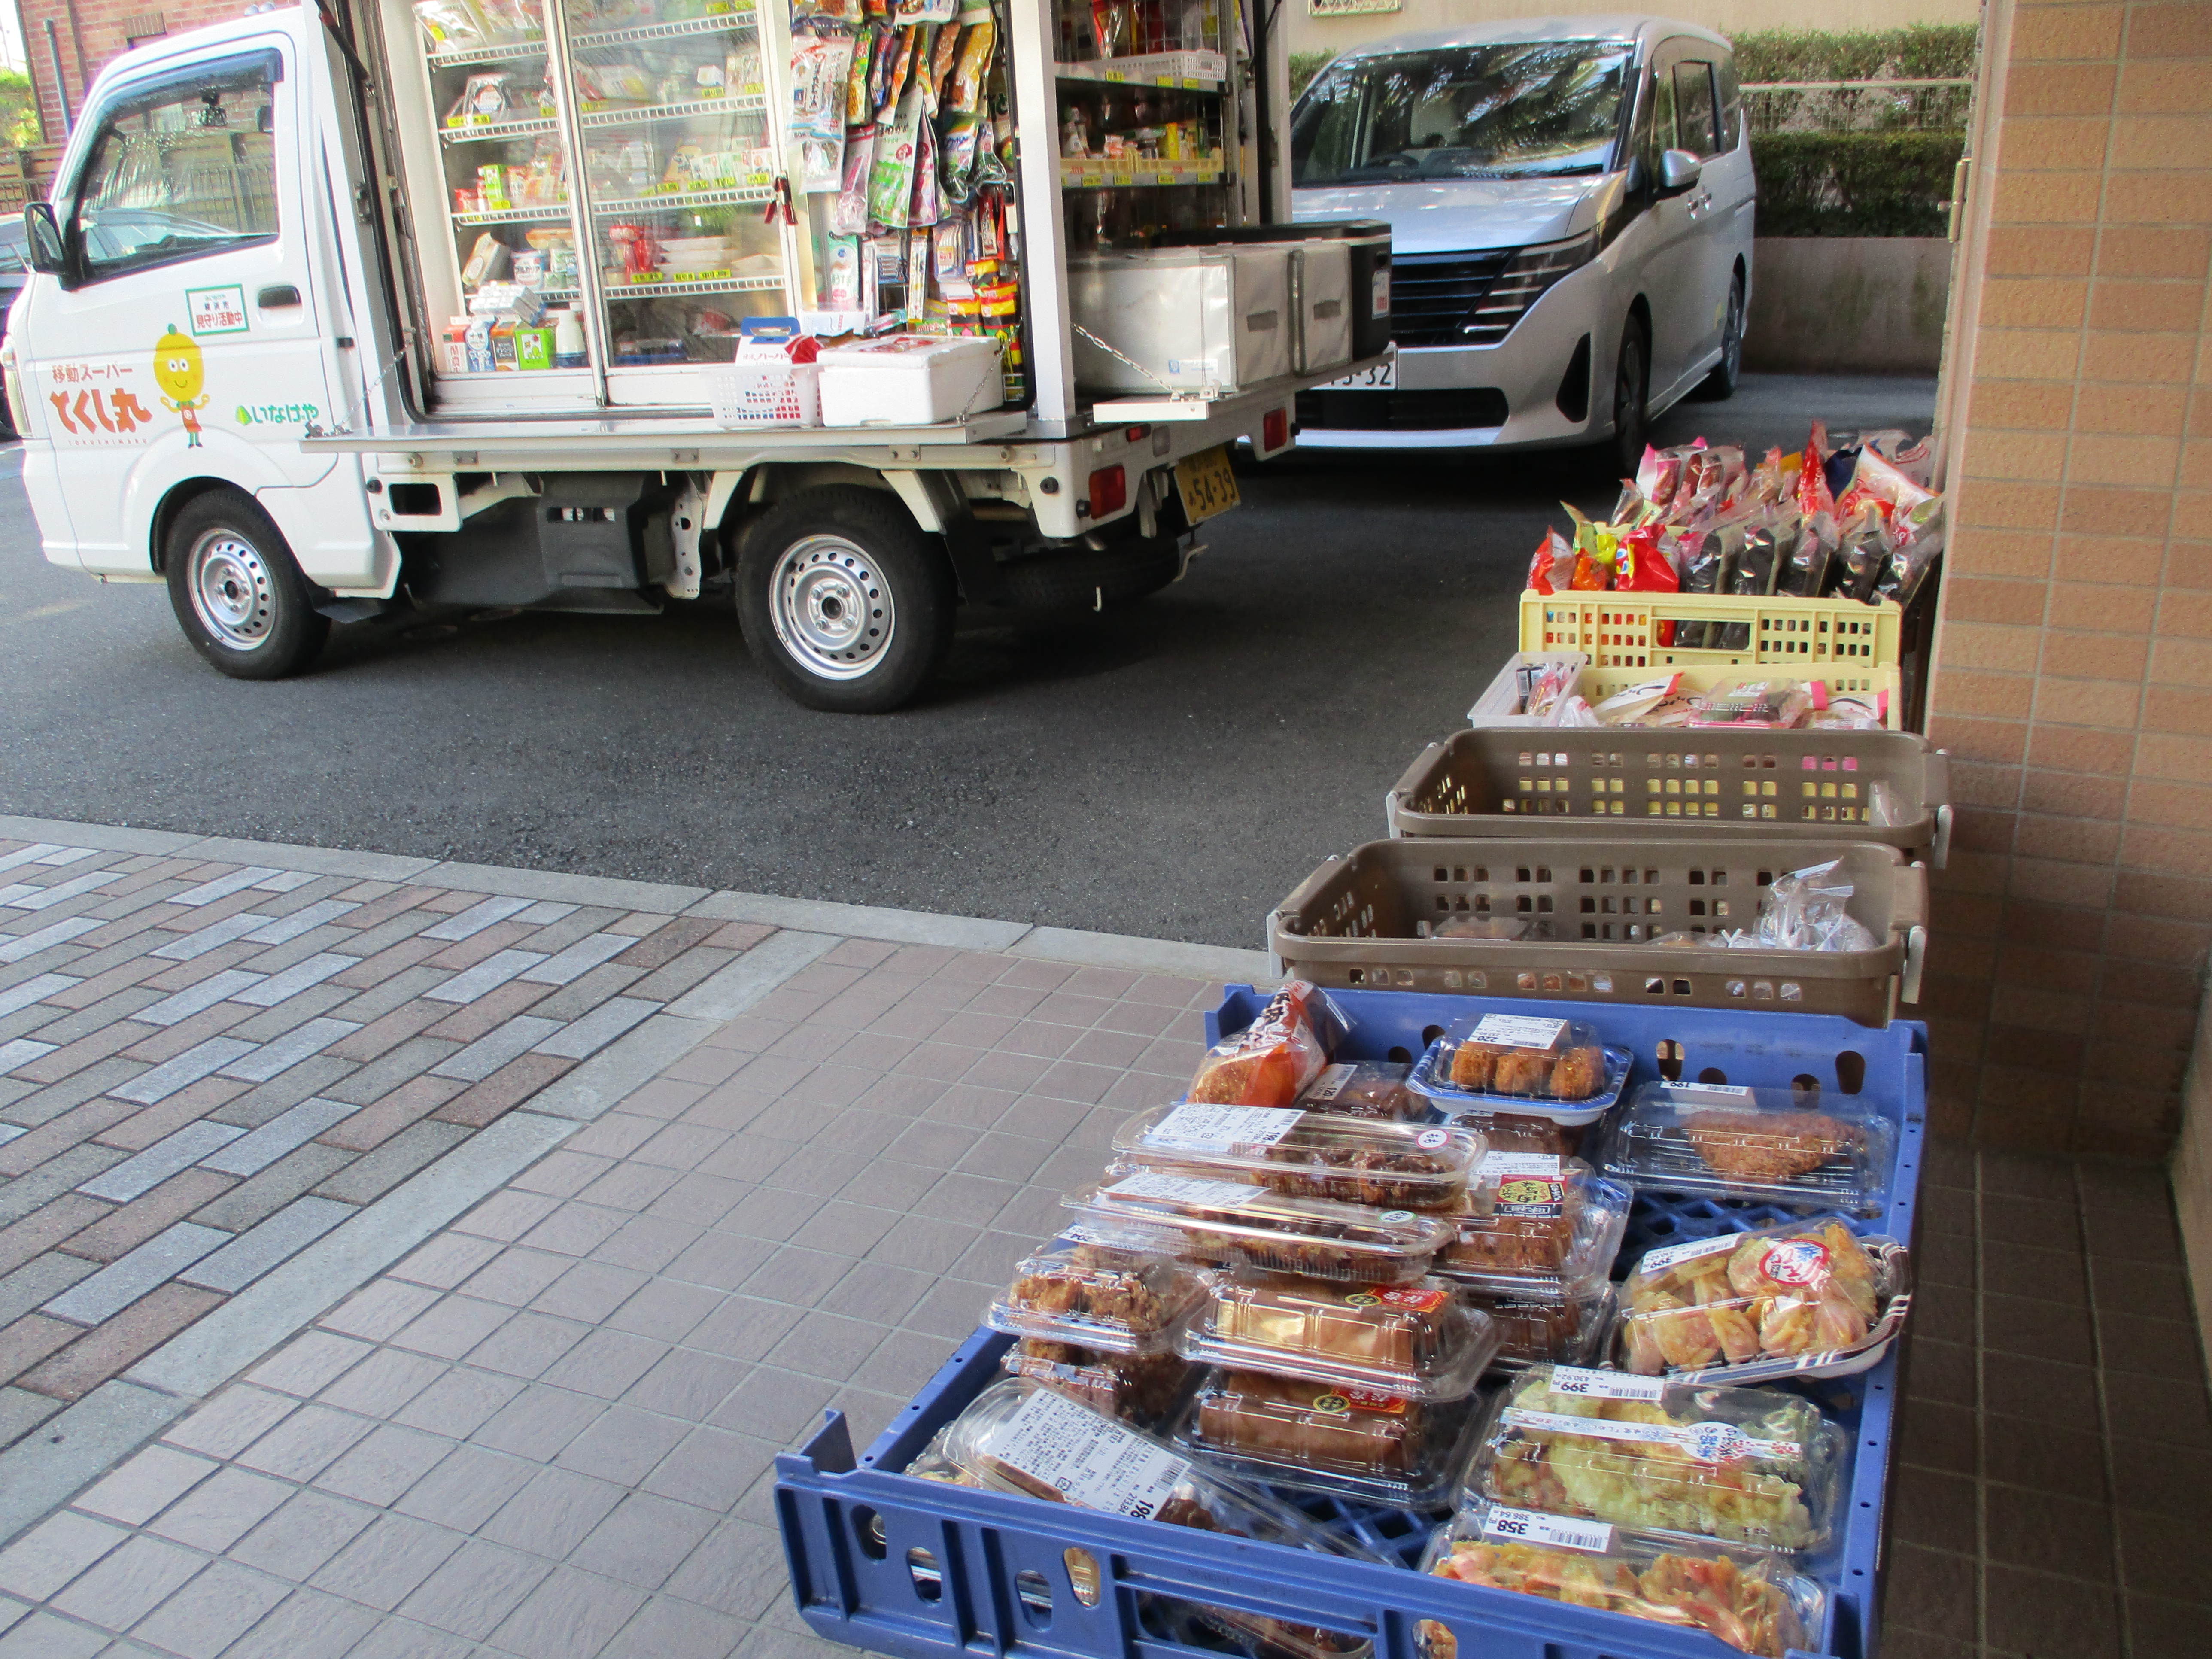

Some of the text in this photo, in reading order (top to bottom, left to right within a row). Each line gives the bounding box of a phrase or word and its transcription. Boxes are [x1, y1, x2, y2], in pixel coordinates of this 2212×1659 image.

[196, 310, 243, 328] 見守り活動中
[52, 362, 133, 383] 移動スーパー
[50, 387, 153, 434] とくし丸
